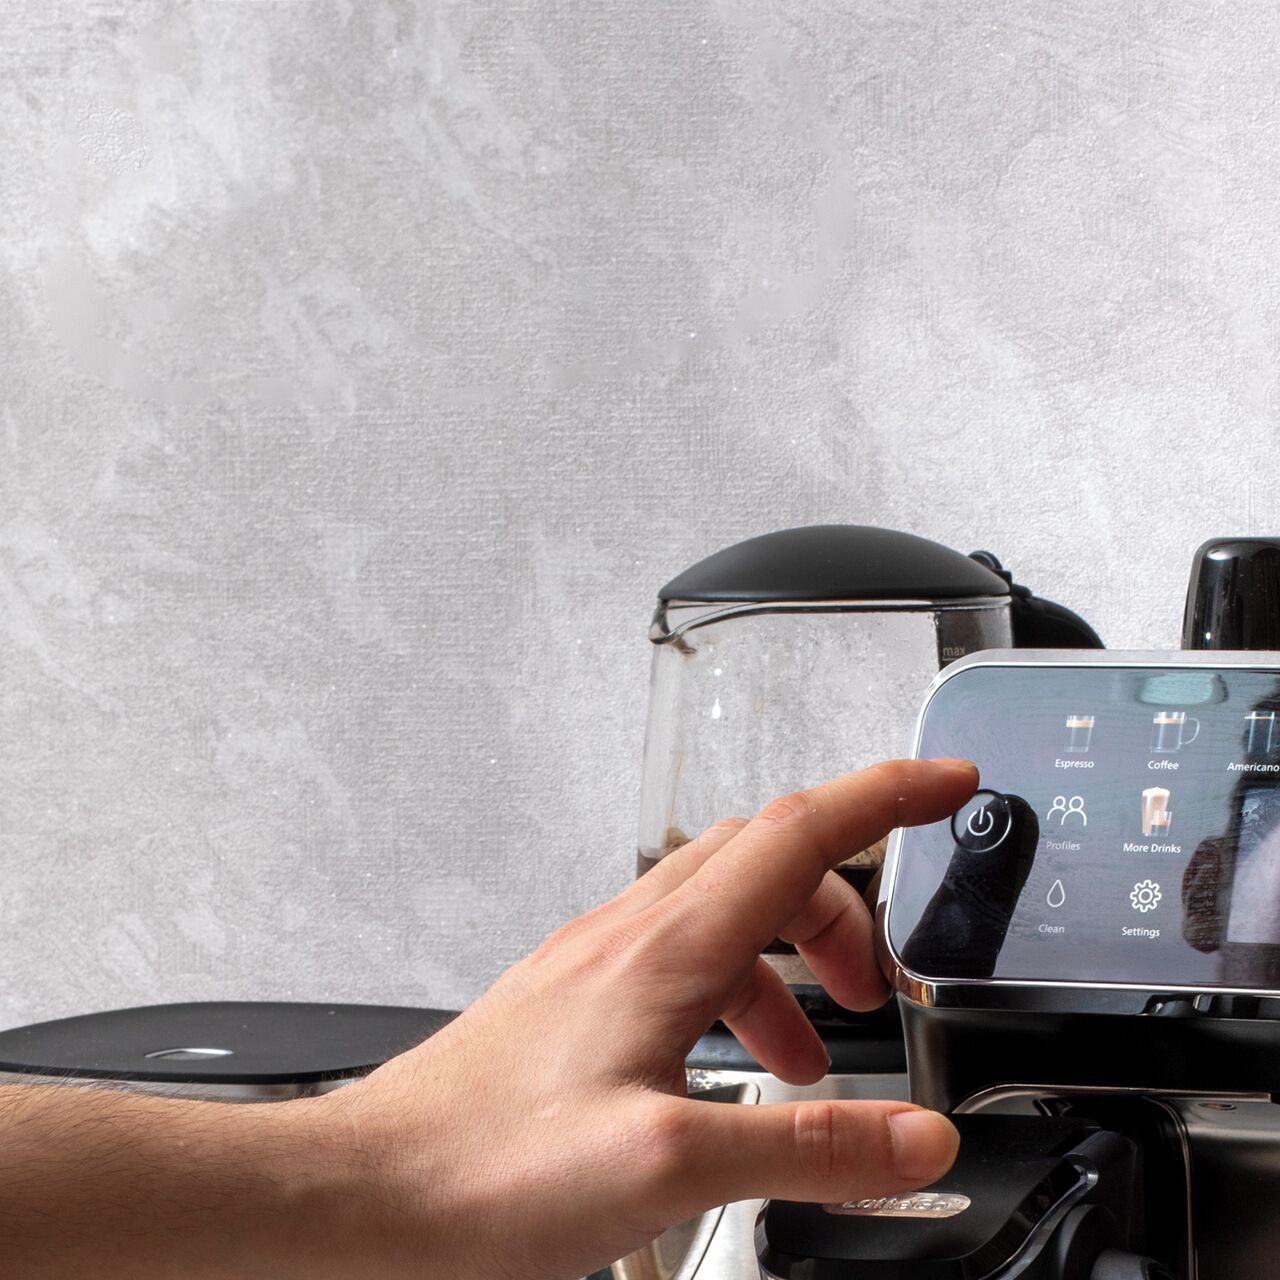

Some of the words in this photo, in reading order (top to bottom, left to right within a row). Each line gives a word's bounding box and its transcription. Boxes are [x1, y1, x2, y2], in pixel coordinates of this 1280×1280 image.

[942, 646, 966, 656] max
[1054, 758, 1095, 770] Espresso
[1147, 760, 1180, 770] Coffee
[1227, 762, 1280, 773] Americano
[1046, 840, 1081, 852] Profiles
[1123, 842, 1149, 853] More
[1151, 843, 1182, 854] Drinks
[1038, 924, 1065, 934] Clean
[1121, 926, 1161, 938] Settings
